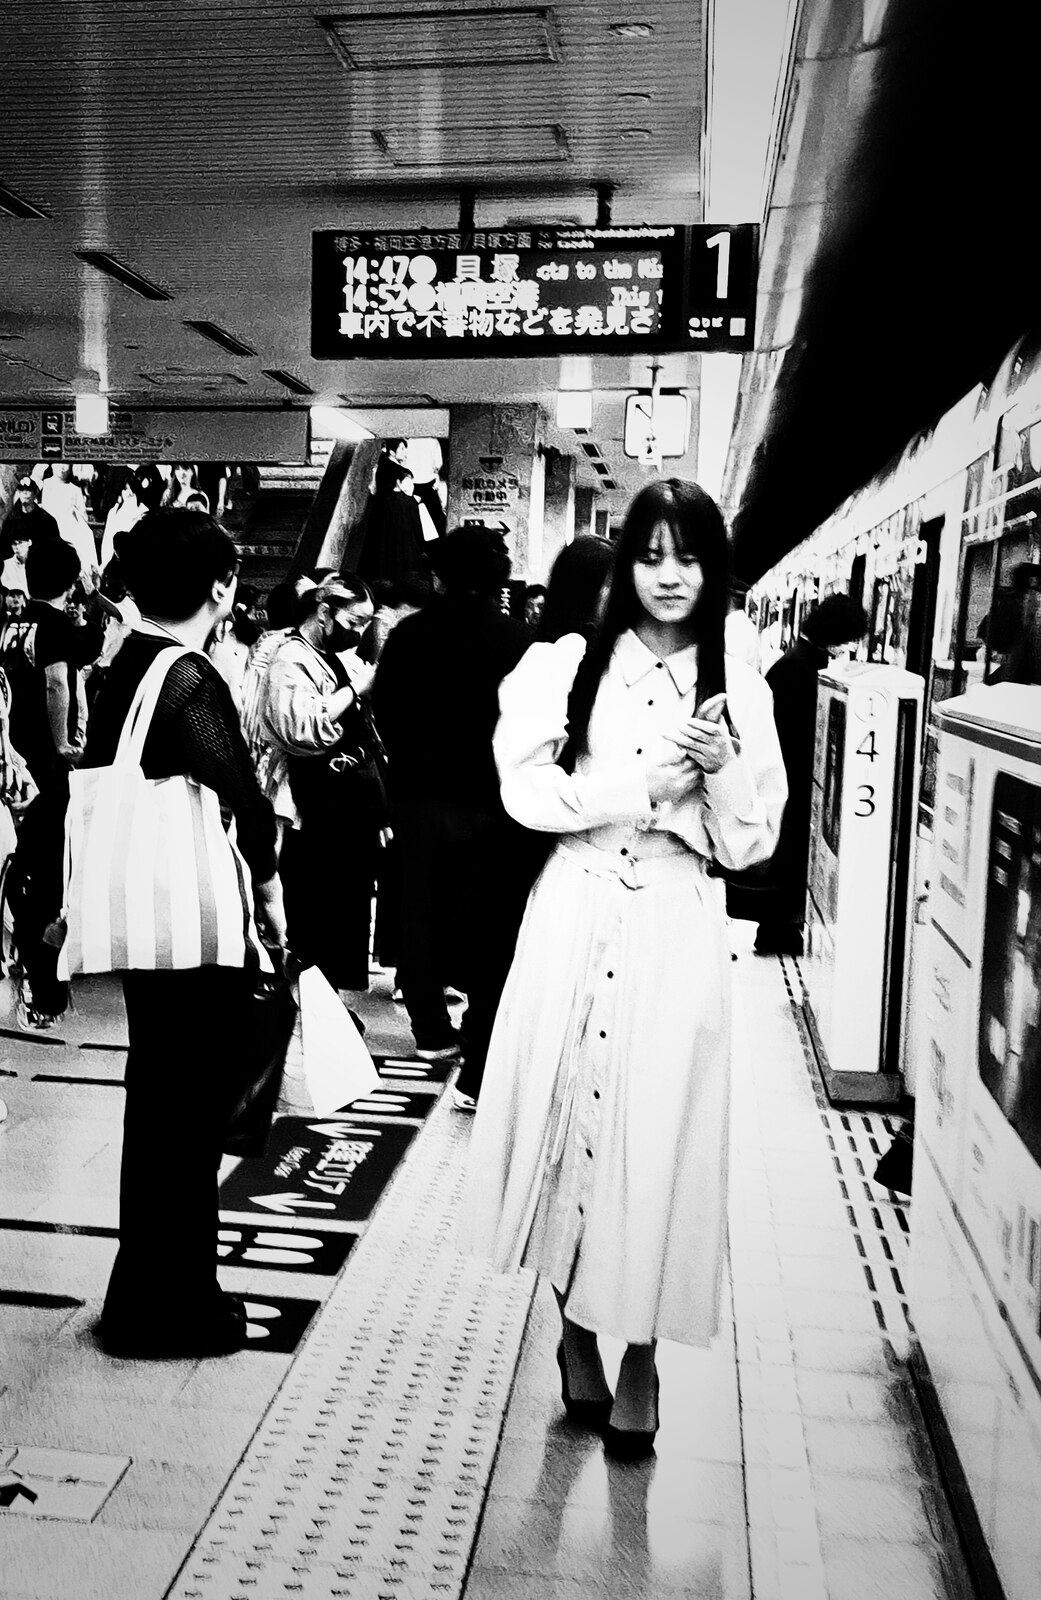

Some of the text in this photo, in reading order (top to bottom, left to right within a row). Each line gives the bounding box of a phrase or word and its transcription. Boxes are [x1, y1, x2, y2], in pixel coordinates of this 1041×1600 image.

[342, 256, 409, 285] 14:47
[706, 231, 731, 299] 1
[342, 284, 408, 312] 14:52
[338, 310, 663, 339] 車内で不審物などを発見さ
[855, 730, 879, 762] 4
[854, 784, 876, 817] 3
